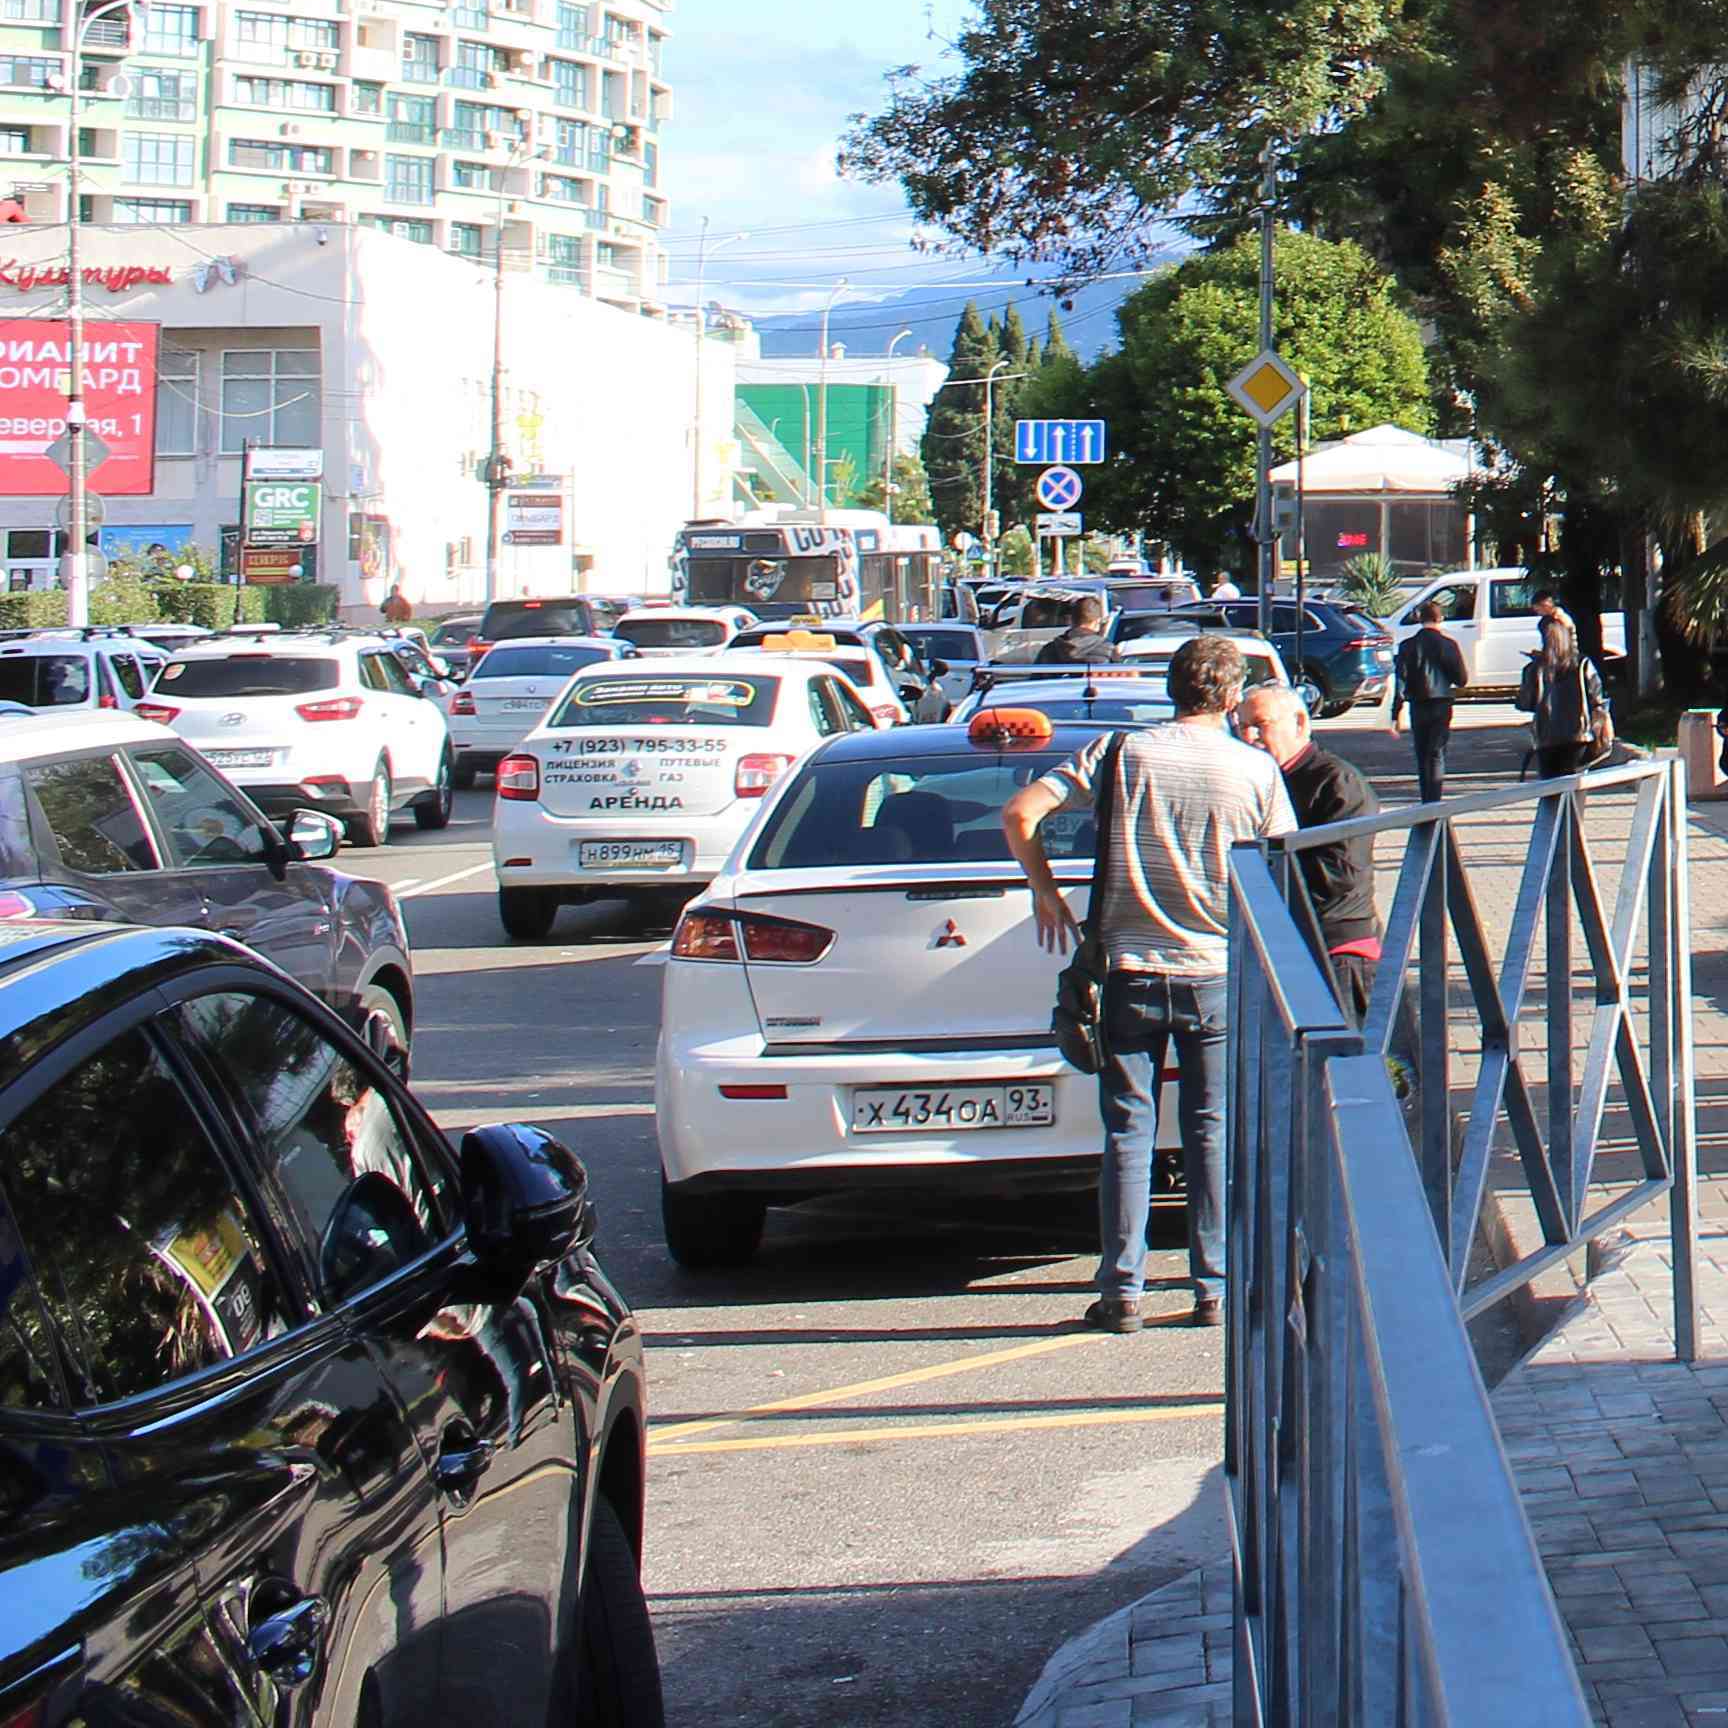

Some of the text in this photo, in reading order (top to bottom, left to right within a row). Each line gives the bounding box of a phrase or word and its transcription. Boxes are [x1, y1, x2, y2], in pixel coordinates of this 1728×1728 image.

[131, 413, 143, 437] 1
[255, 487, 309, 509] GRC
[552, 739, 727, 756] +7 (923) 795-33-55
[547, 759, 615, 770] ЛИЦЕНЗИЯ
[544, 773, 617, 784] СТРАХОВКА
[659, 772, 684, 782] ГАЗ
[589, 796, 683, 810] АРЕНДА
[1008, 1087, 1041, 1112] 93
